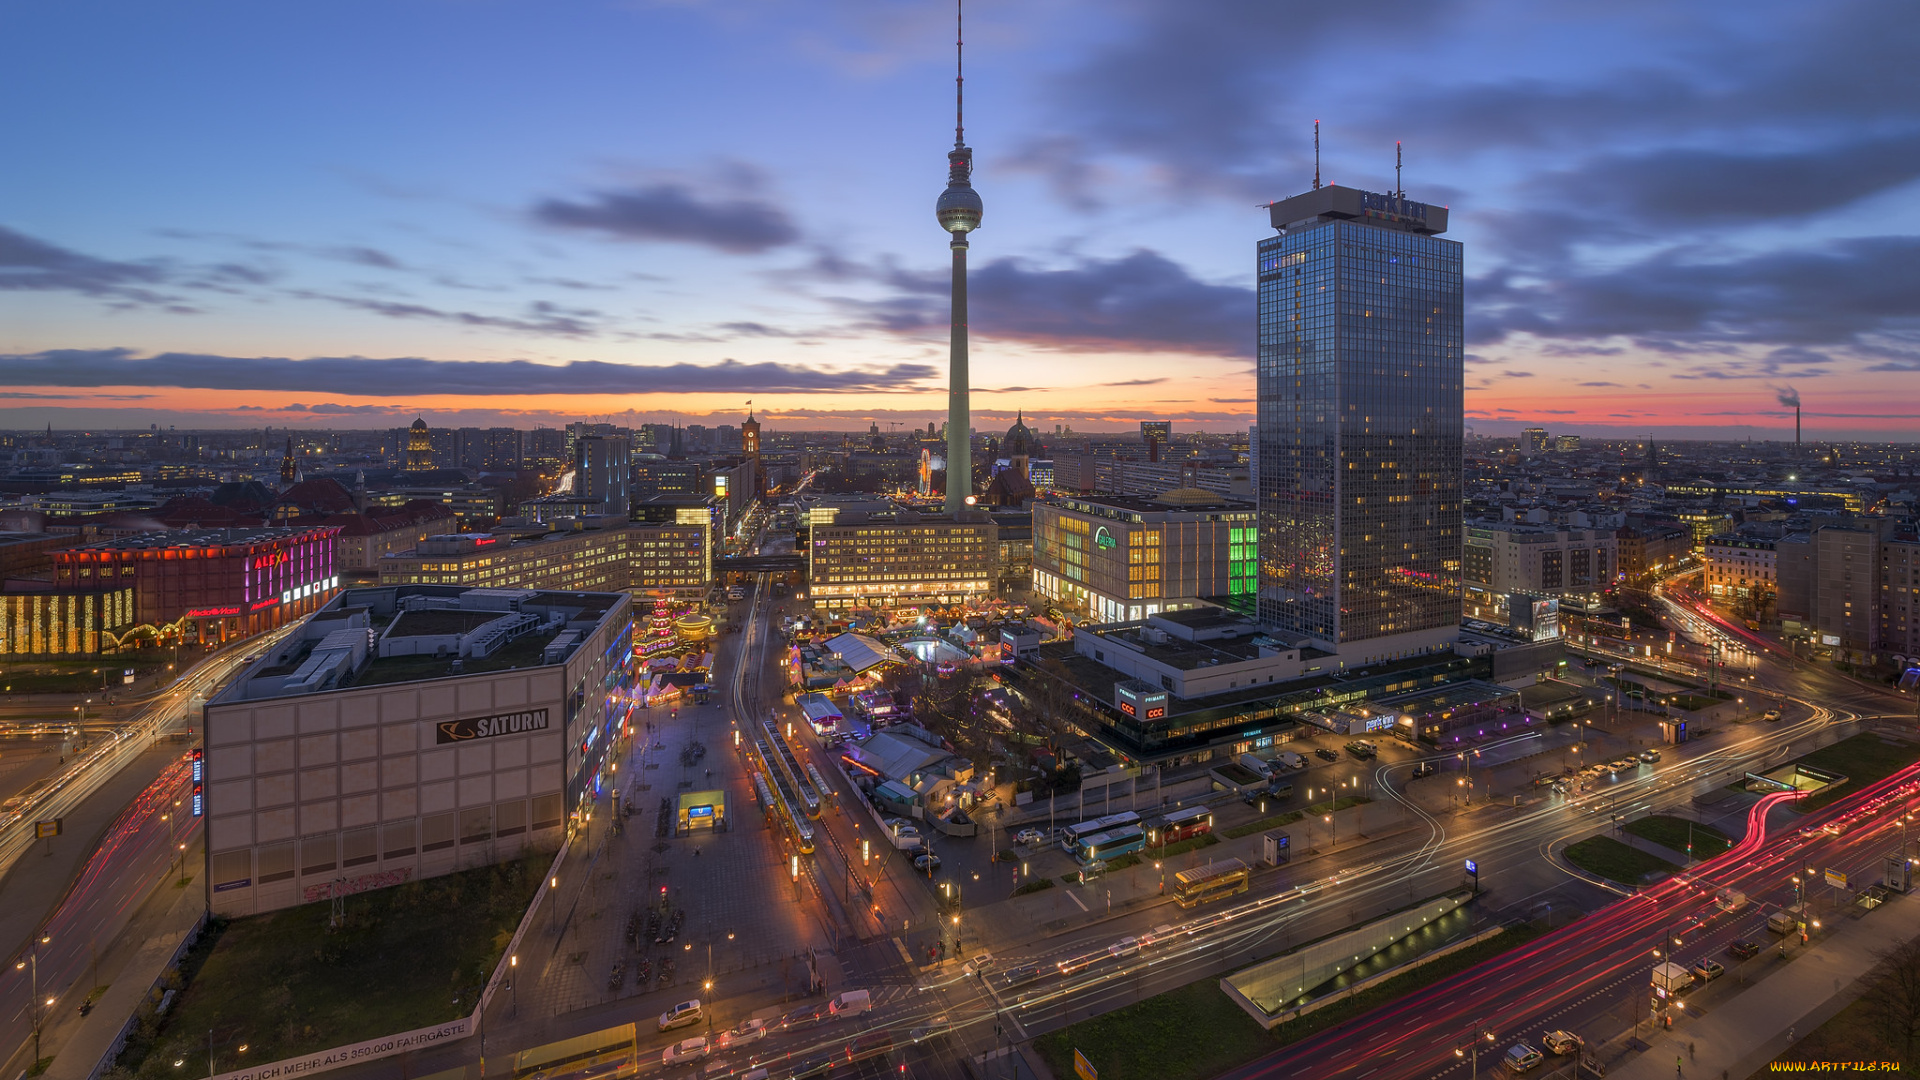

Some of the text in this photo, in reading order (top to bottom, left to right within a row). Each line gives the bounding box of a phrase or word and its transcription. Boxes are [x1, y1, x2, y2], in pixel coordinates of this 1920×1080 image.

[1360, 189, 1427, 220] park inn
[254, 549, 289, 570] ALEXA
[1119, 688, 1136, 700] PRIMARK
[1121, 702, 1135, 715] CCC
[1148, 708, 1163, 718] CCC
[477, 711, 546, 737] SATURN
[1366, 716, 1382, 732] park
[1383, 715, 1394, 725] inn
[284, 1058, 321, 1075] MEHR
[324, 1052, 348, 1065] ALS
[351, 1041, 394, 1059] 350.000
[396, 1024, 465, 1048] FAHRGÄSTE
